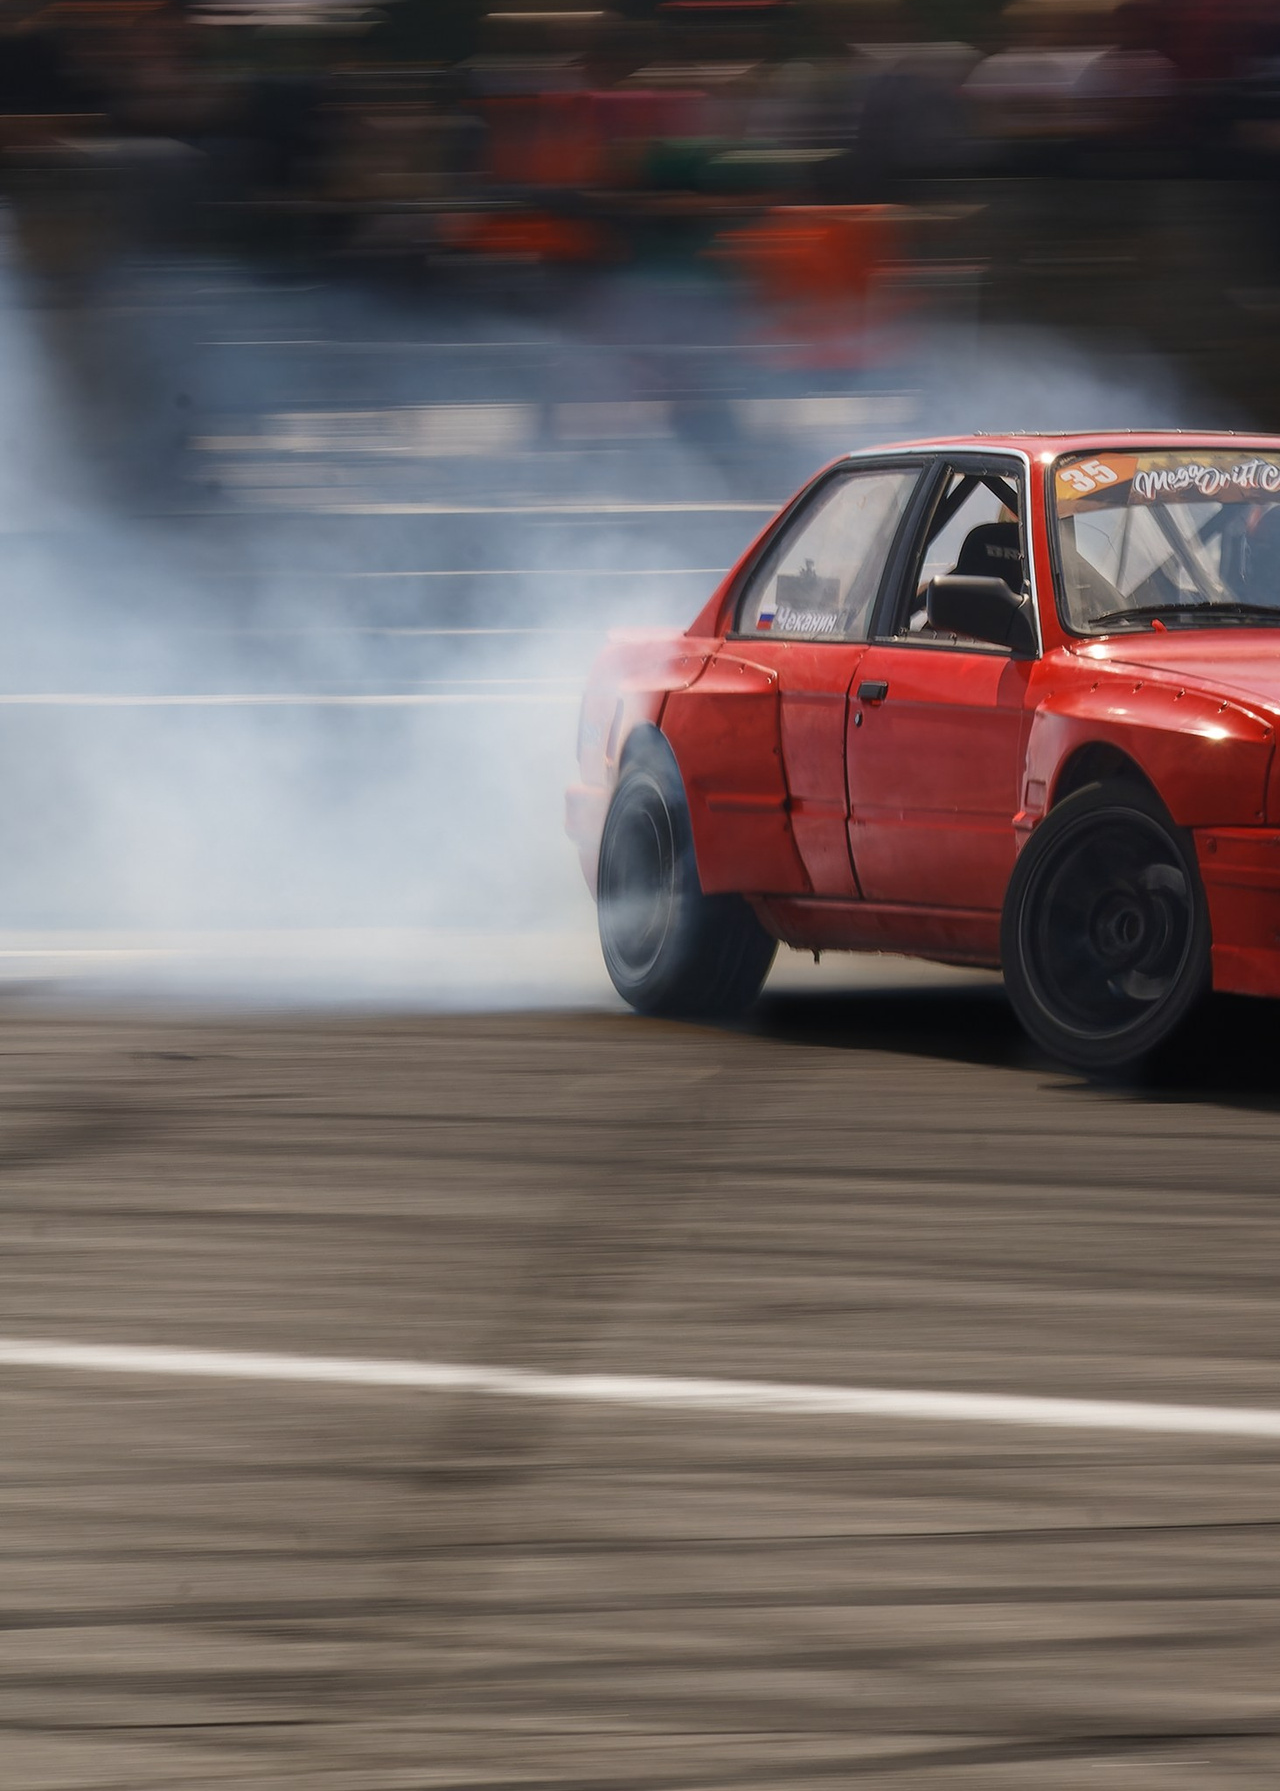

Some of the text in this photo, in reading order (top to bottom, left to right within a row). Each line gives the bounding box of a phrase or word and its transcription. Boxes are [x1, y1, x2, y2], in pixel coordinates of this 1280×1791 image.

[1060, 459, 1118, 493] 35
[1134, 464, 1202, 499] Mega
[1196, 458, 1263, 495] Drift
[777, 606, 837, 632] Чеканин
